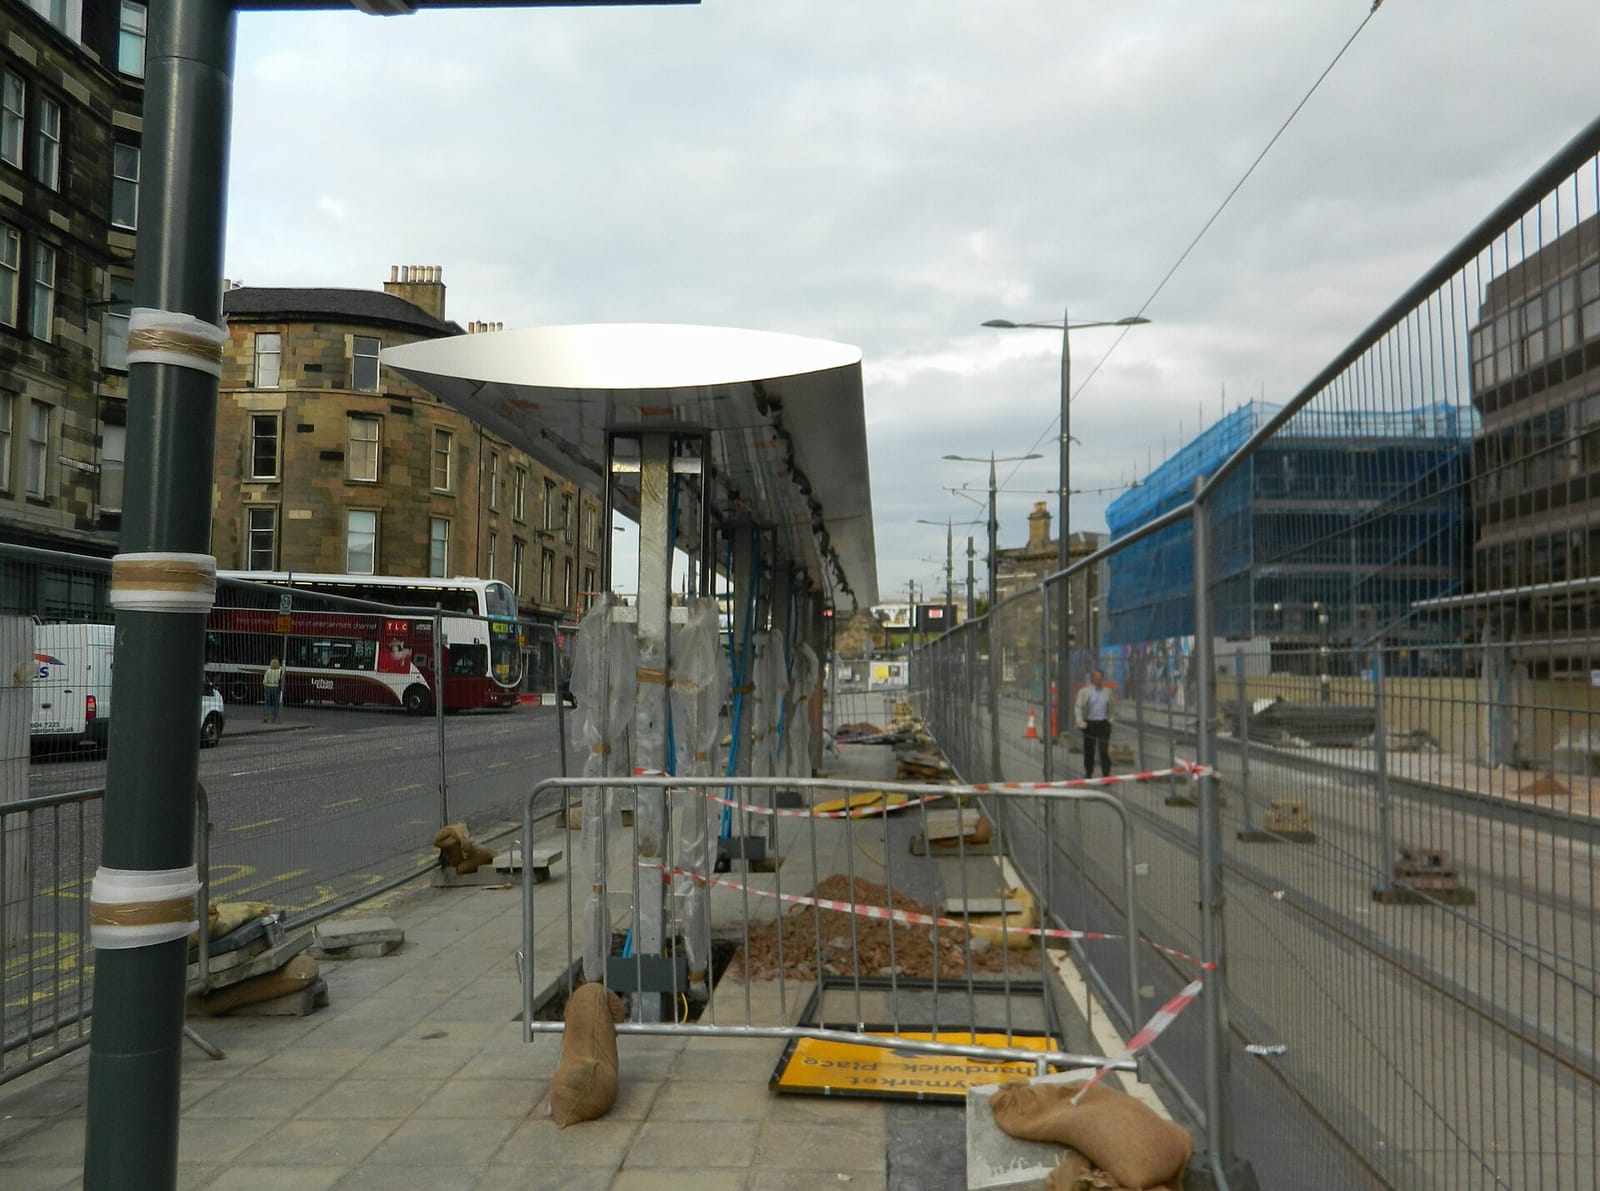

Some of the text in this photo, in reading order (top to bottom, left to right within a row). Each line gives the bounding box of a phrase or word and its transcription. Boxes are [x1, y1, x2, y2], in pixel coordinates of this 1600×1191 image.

[387, 623, 407, 631] TLC
[803, 1057, 1038, 1078] handwick Place
